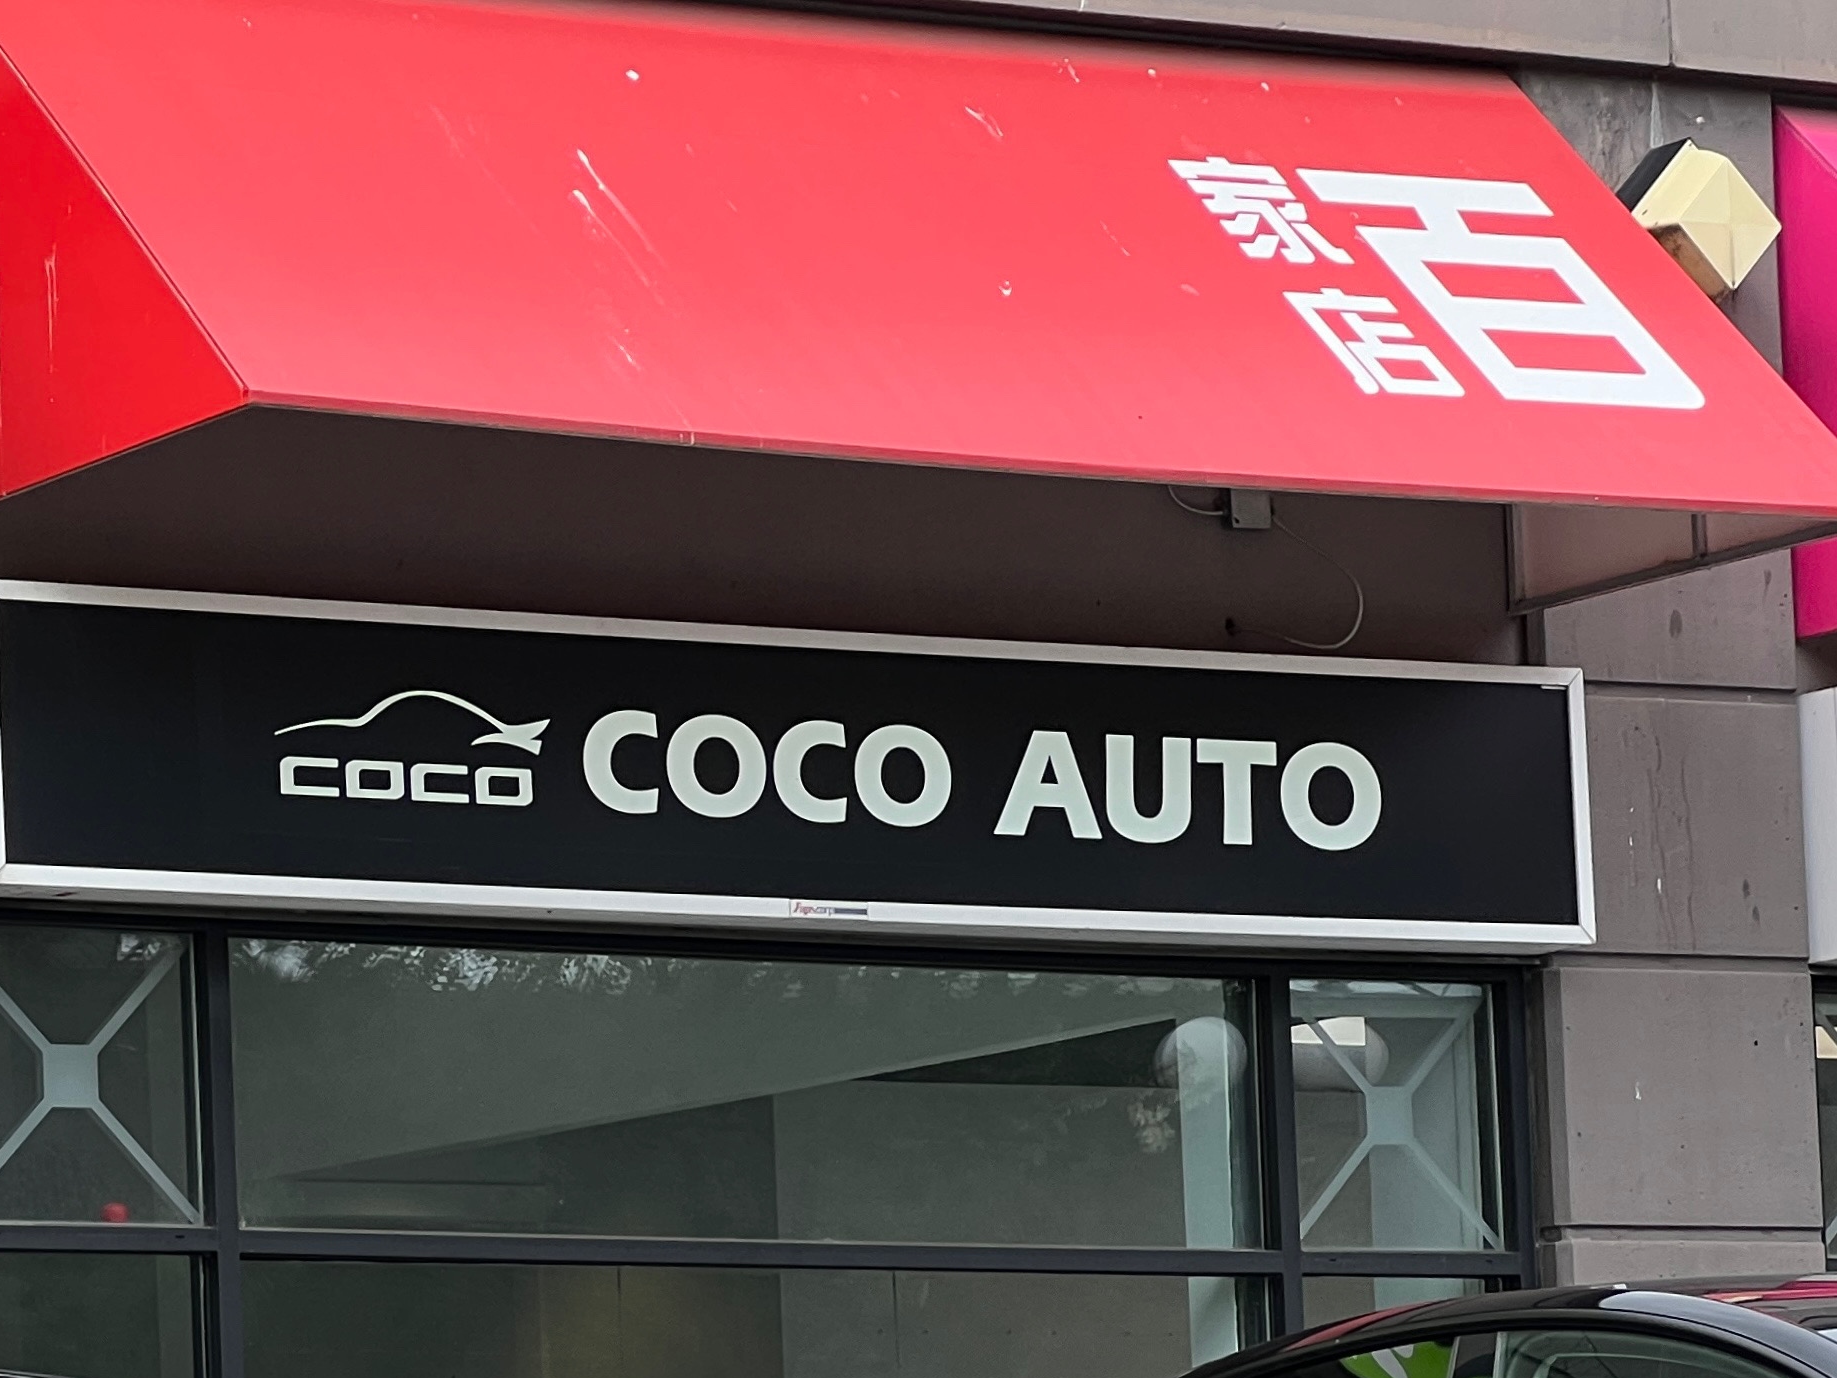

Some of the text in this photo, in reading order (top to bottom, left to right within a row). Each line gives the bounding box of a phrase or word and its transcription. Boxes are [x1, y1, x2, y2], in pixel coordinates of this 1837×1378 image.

[279, 755, 535, 808] COCO
[581, 708, 1383, 852] COCO AUTO
